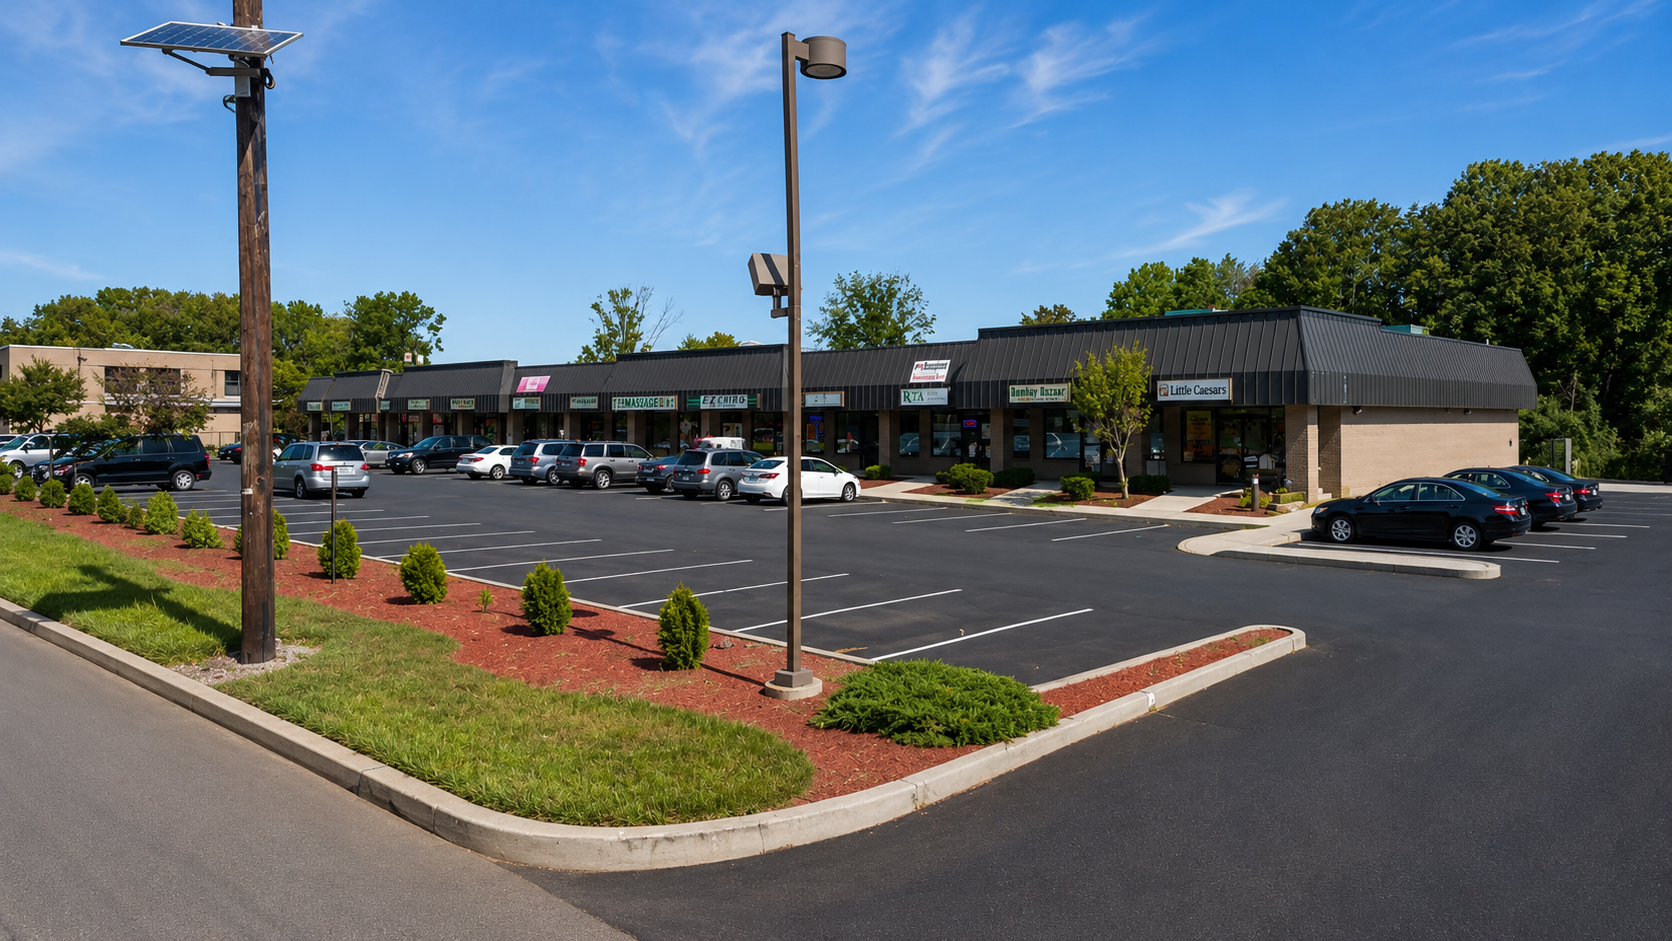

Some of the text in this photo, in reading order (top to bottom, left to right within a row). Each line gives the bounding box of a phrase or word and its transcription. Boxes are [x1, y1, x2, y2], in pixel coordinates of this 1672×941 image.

[1170, 384, 1227, 396] Little Caesars
[624, 397, 659, 408] MASSAGE
[903, 390, 924, 403] RTA
